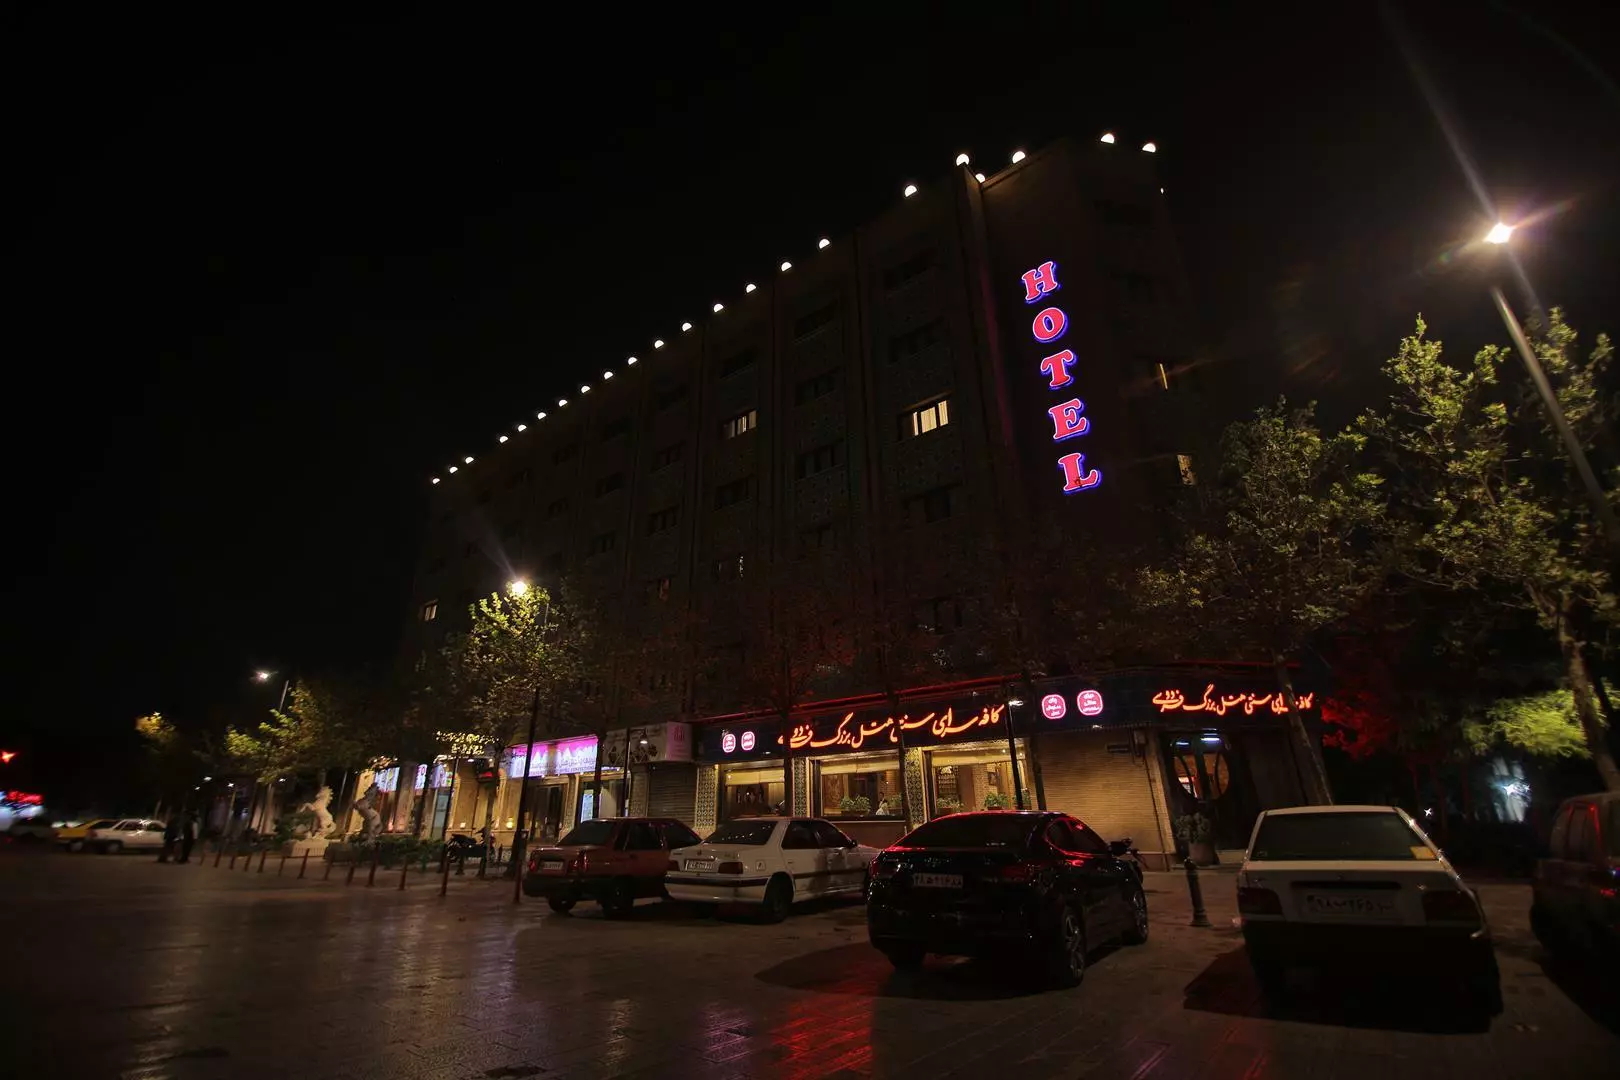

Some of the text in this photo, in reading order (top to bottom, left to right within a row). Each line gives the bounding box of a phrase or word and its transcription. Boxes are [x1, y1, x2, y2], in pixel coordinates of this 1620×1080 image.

[1021, 260, 1101, 493] HOTEL
[1182, 683, 1217, 711] بزرگ
[1216, 693, 1247, 716] هتل
[809, 711, 854, 746] بزرگ
[931, 706, 979, 738] سرای
[978, 703, 1004, 727] کافه
[851, 716, 895, 749] هتل
